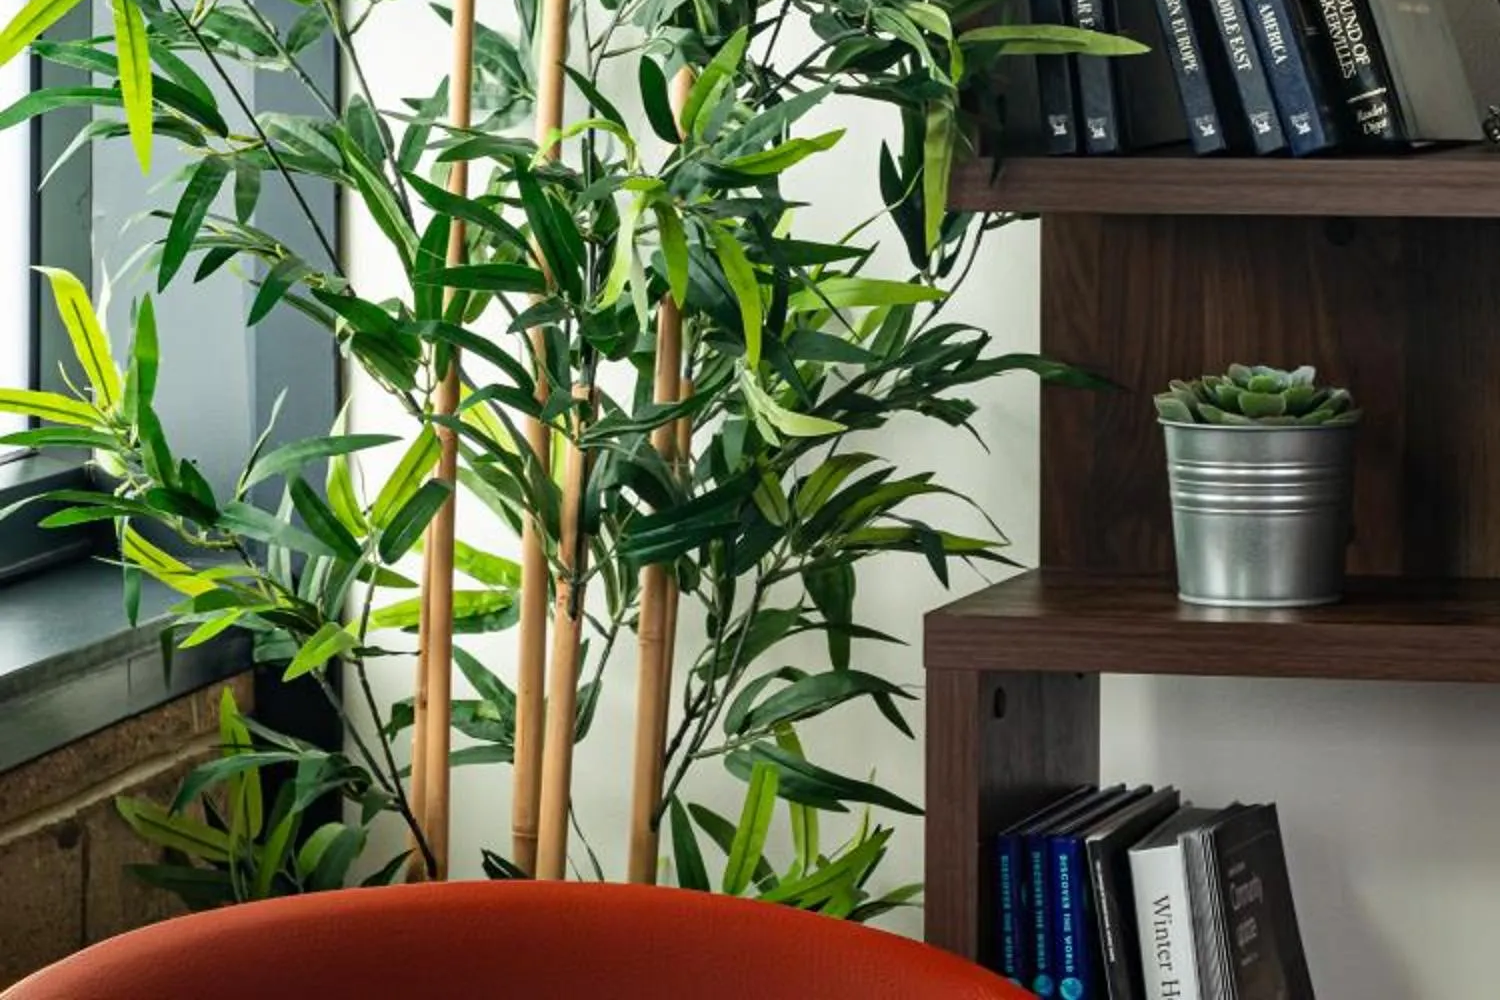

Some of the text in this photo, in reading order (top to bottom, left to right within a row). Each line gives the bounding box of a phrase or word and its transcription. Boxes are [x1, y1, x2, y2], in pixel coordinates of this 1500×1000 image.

[1171, 17, 1200, 75] EUROPE
[1228, 36, 1253, 73] EAST
[1258, 3, 1289, 66] AMERICA
[1351, 42, 1372, 67] OF
[1152, 895, 1173, 971] Winter
